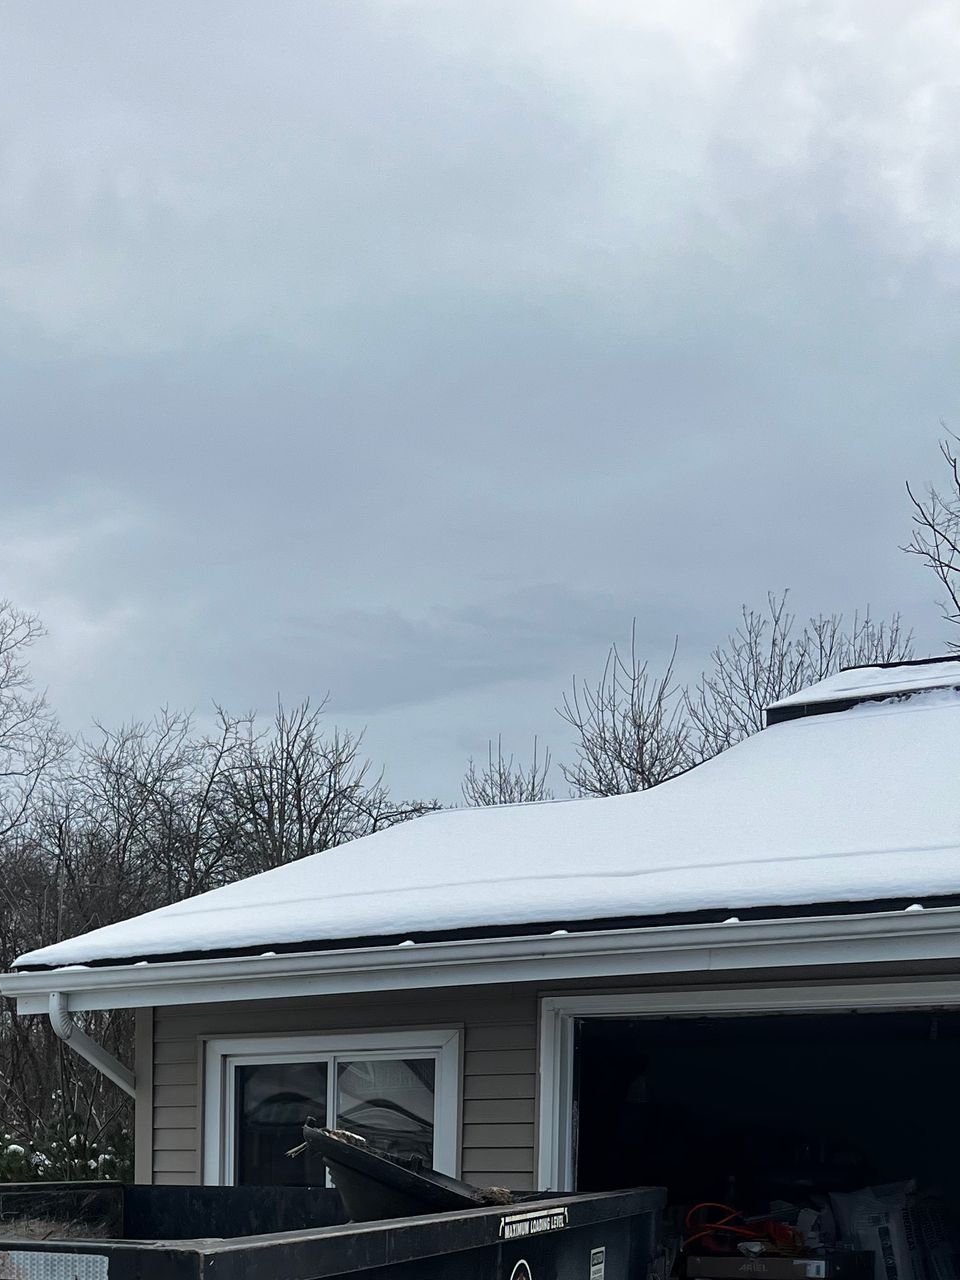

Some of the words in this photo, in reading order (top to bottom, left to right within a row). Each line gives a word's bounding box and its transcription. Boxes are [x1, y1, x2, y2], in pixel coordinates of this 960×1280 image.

[504, 1221, 530, 1239] MAXIMUM
[530, 1217, 551, 1234] LOADING
[551, 1215, 565, 1230] LEVEL
[738, 1264, 768, 1272] ARIEL
